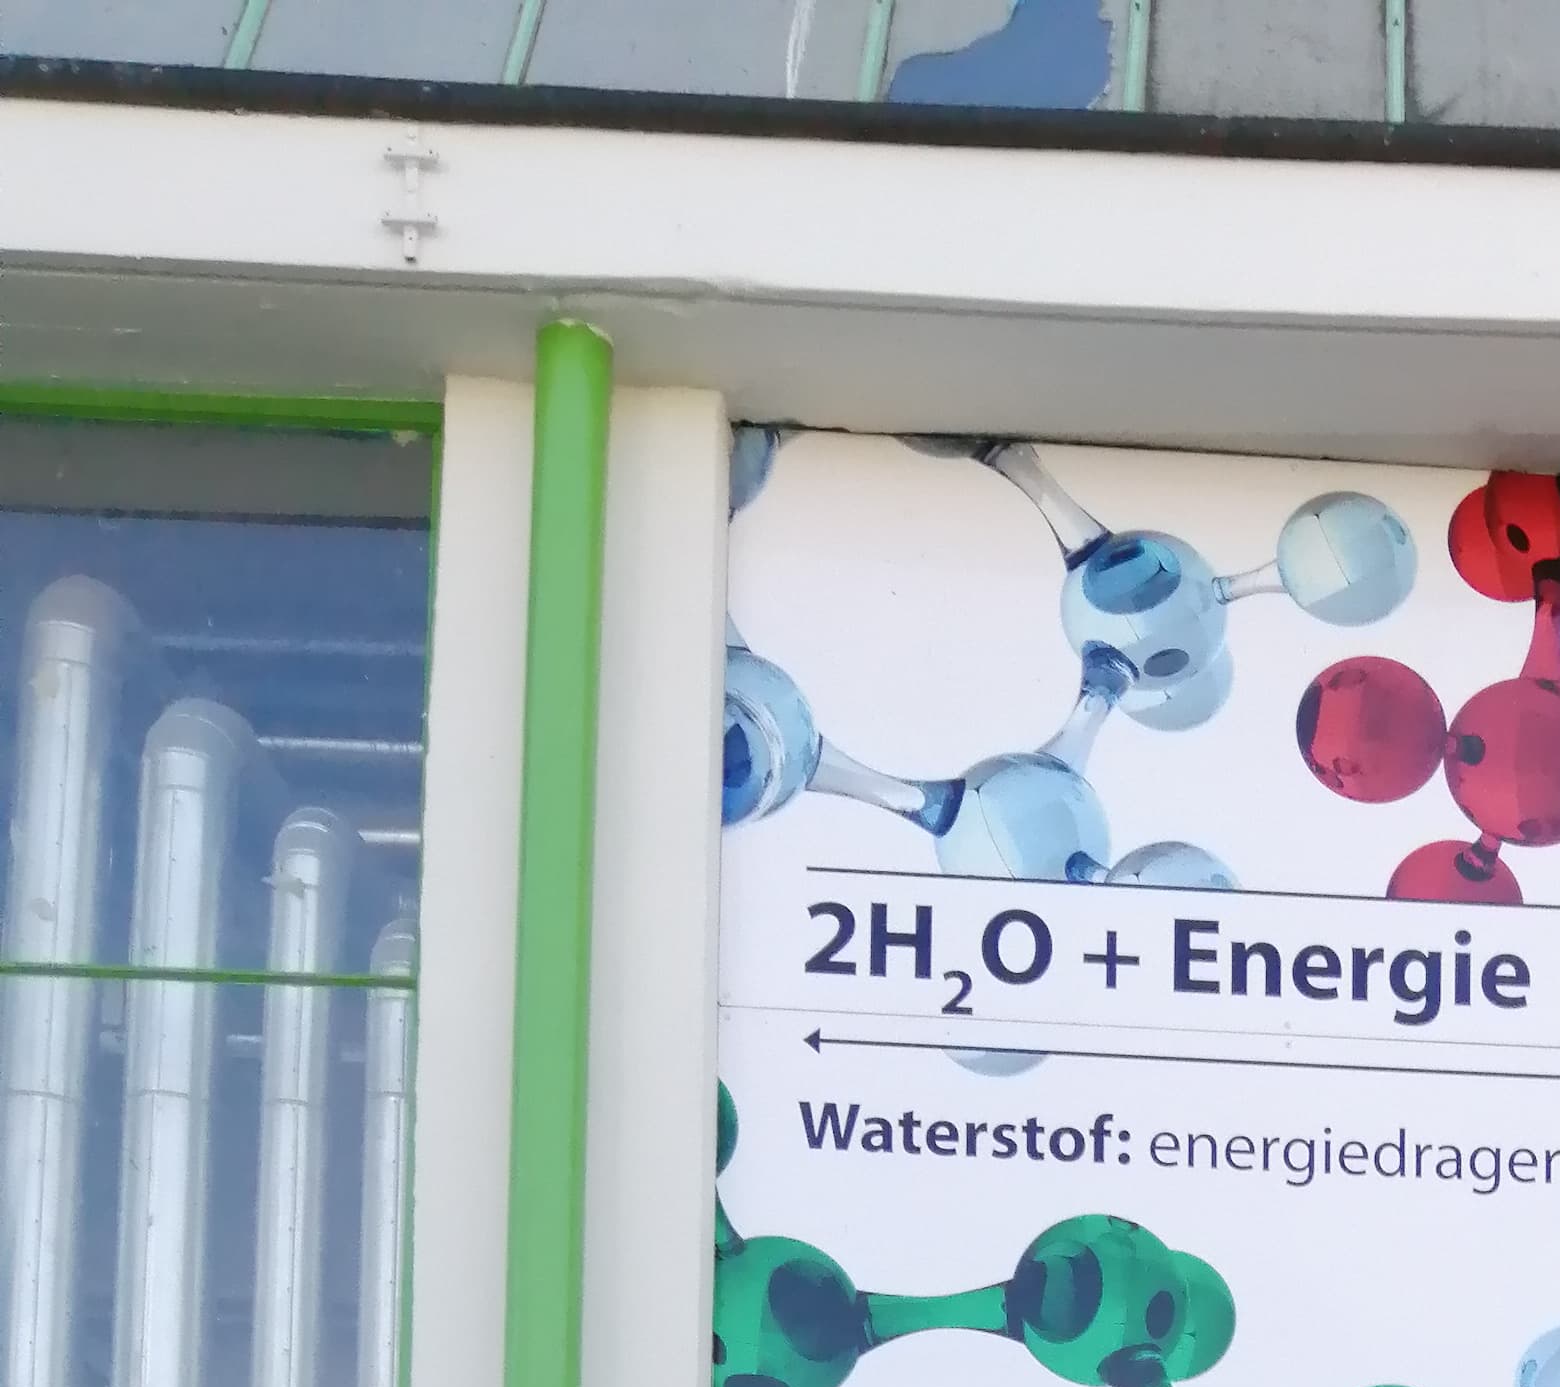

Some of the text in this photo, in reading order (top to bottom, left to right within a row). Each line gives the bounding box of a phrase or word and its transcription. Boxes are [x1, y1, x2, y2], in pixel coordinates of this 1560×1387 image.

[1083, 930, 1140, 989] +
[1173, 918, 1531, 1026] Energie
[798, 1101, 1131, 1165] Waterstof:
